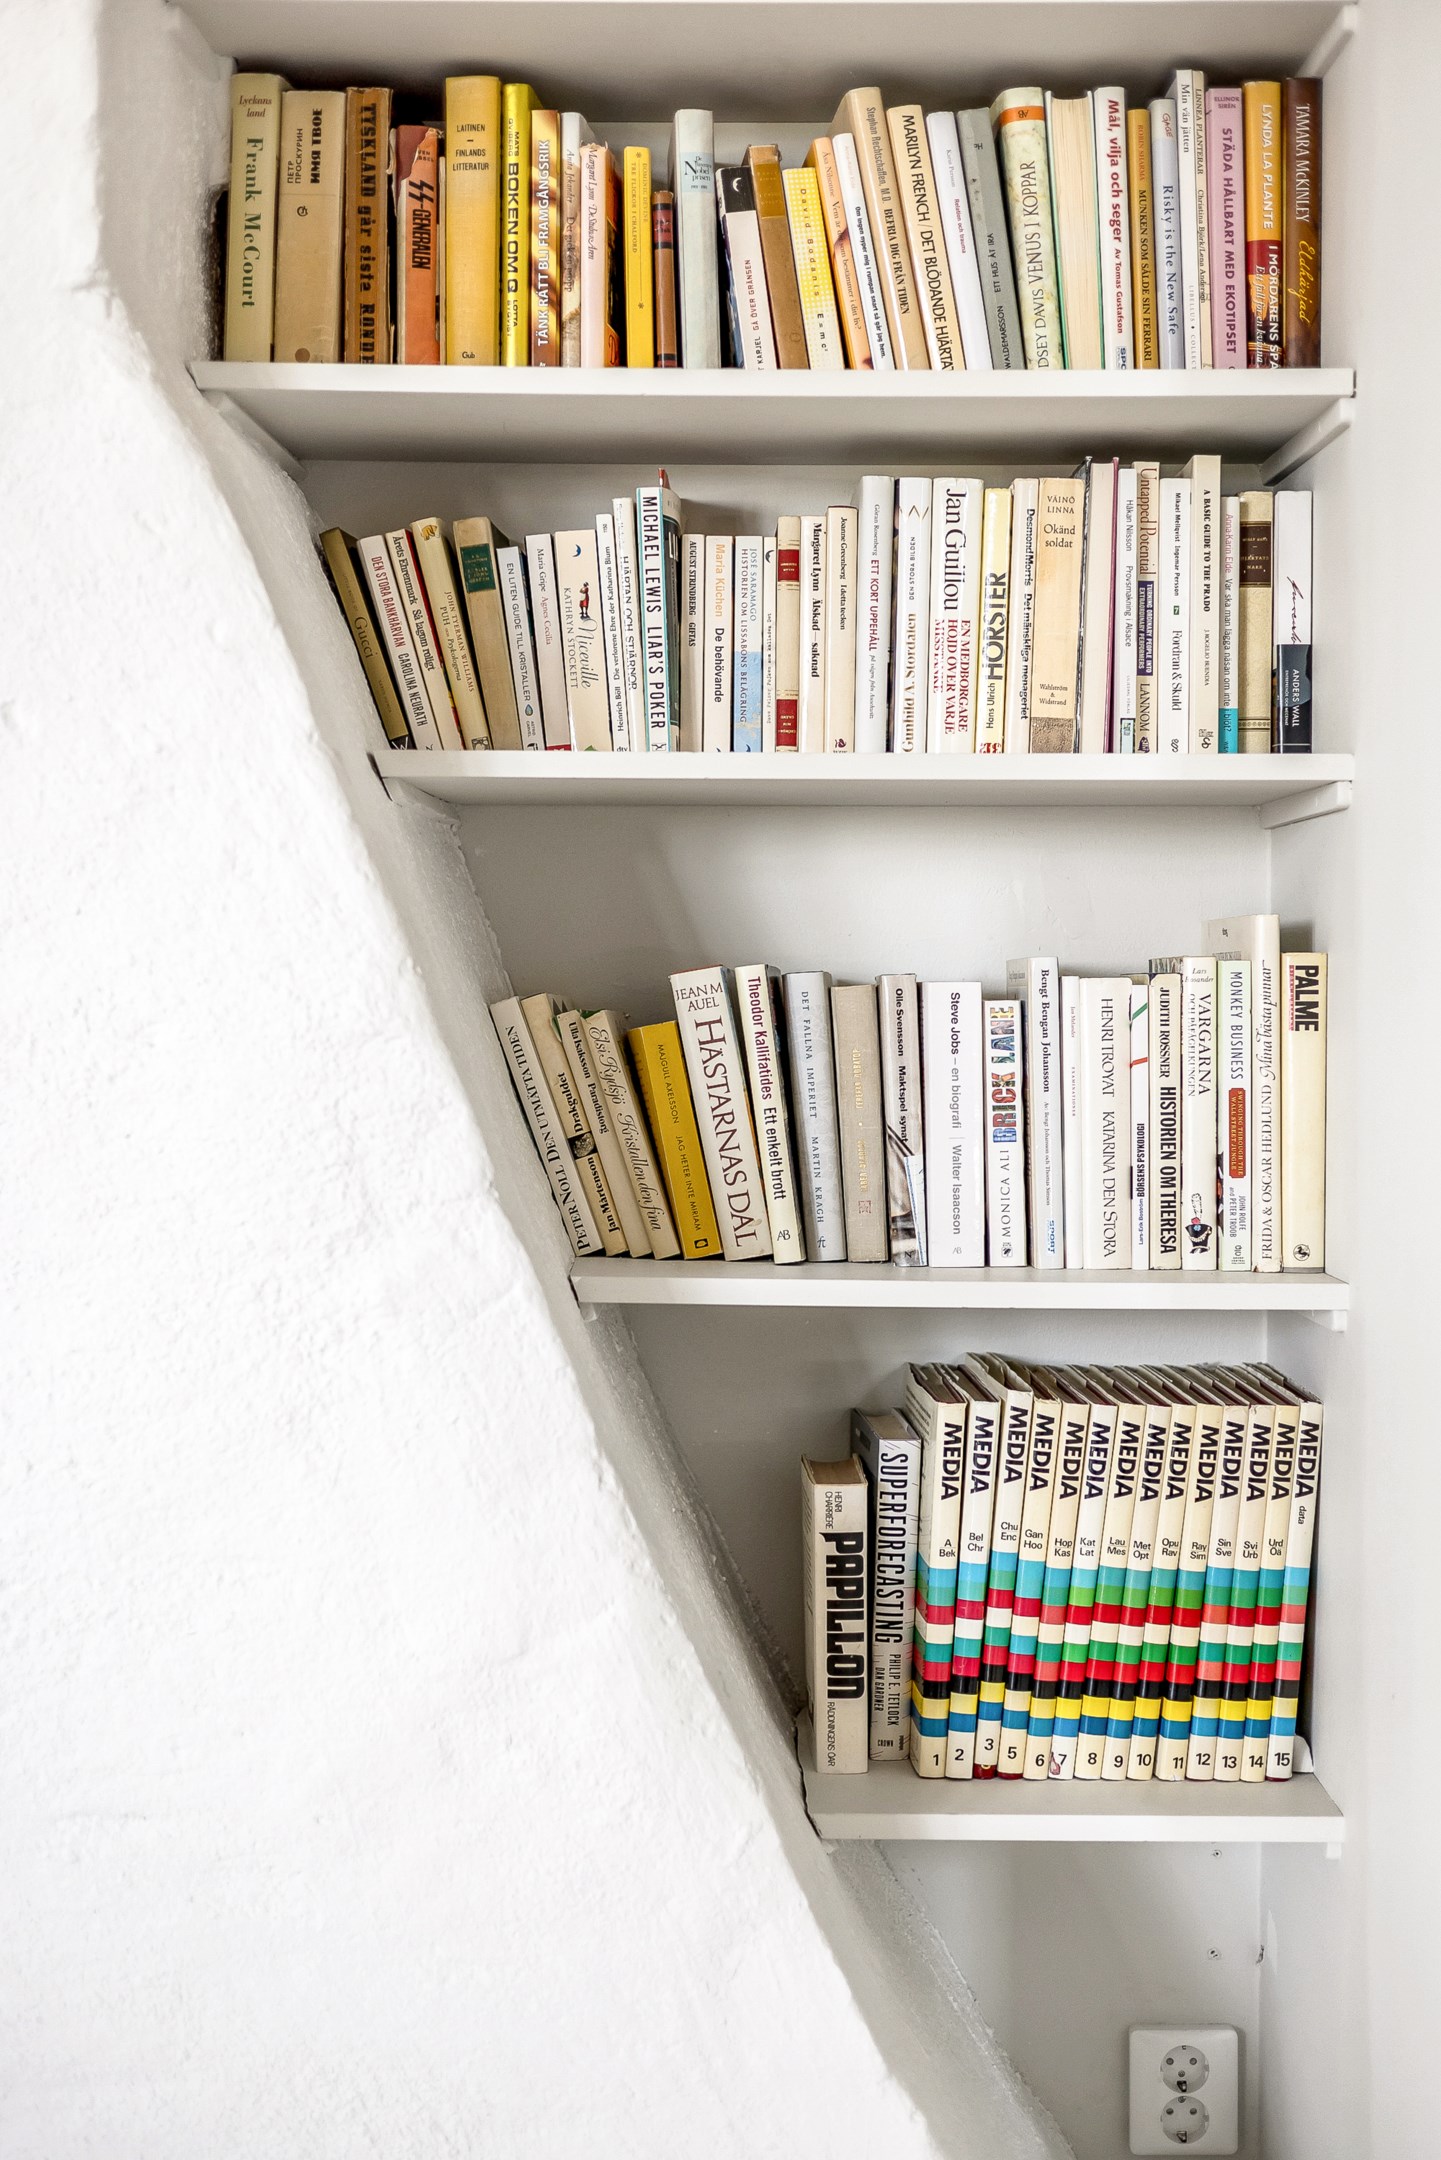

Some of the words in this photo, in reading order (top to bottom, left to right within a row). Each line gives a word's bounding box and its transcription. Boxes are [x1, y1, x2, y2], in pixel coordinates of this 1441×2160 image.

[239, 96, 272, 106] Lyckans
[247, 108, 265, 117] land
[1107, 99, 1123, 131] Mål,
[310, 108, 322, 147] ТВОЕ
[457, 124, 485, 133] LAITINEN
[901, 115, 922, 169] MARILYN
[1262, 104, 1273, 147] LYNDA
[1295, 103, 1311, 157] TAMARA
[295, 128, 303, 184] ПРОСКУРИН
[310, 151, 320, 184] ИМЯ
[360, 103, 376, 197] TYSKLAND
[453, 162, 489, 172] LITTERATUR
[456, 149, 486, 157] FINLANDS
[1106, 138, 1122, 167] vilja
[1222, 128, 1235, 172] STÄDA
[1263, 152, 1273, 169] LA
[245, 138, 263, 202] Frank
[1111, 172, 1123, 198] och
[507, 163, 518, 235] BOKEN
[536, 140, 551, 247] FRAMGÅNGSRIK
[911, 173, 930, 221] FRENCH
[1161, 185, 1175, 223] Risky
[1263, 174, 1273, 229] PLANTE
[1295, 160, 1311, 222] McKINLEY
[357, 206, 376, 236] går
[1109, 203, 1123, 243] seger
[1223, 178, 1237, 245] HÅLLBART
[919, 230, 935, 253] DET
[1165, 229, 1175, 240] is
[242, 213, 262, 308] McCourt
[360, 246, 375, 290] sista
[507, 240, 518, 273] OM
[538, 250, 550, 270] BLI
[1166, 245, 1176, 266] the
[1226, 251, 1235, 279] MED
[507, 278, 518, 294] Q
[537, 273, 550, 306] RÄTT
[924, 257, 946, 323] BLÖDANDE
[1167, 272, 1177, 301] New
[1288, 240, 1315, 322] Eldhärjad
[537, 310, 549, 346] TÄNK
[1168, 307, 1178, 335] Safe
[1226, 284, 1237, 354] EKOTIPSET
[945, 489, 967, 523] Jan
[1047, 495, 1075, 503] VÄINÖ
[1047, 506, 1075, 514] LINNA
[1136, 468, 1157, 523] Untapped
[1203, 498, 1211, 521] BASIC
[643, 496, 661, 561] MICHAEL
[1043, 524, 1076, 535] Okänd
[1045, 540, 1073, 548] soldat
[1203, 524, 1211, 548] GUIDE
[715, 544, 725, 573] Maria
[871, 559, 879, 574] ETT
[943, 529, 967, 611] Guillou
[1139, 527, 1156, 575] Potential
[1203, 551, 1211, 562] TO
[645, 568, 661, 613] LEWIS
[715, 578, 726, 617] Küchen
[870, 578, 879, 602] KORT
[1203, 583, 1211, 612] PRADO
[563, 588, 574, 634] KATHRYN
[869, 606, 880, 651] UPPEHÅLL
[354, 617, 378, 659] Gucci
[575, 619, 599, 689] Niceville
[647, 627, 663, 674] LIAR'S
[714, 628, 725, 642] De
[567, 638, 578, 689] STOCKETT
[714, 646, 725, 703] behövande
[1291, 669, 1300, 702] ANDERS
[650, 682, 666, 729] POKER
[1139, 683, 1150, 731] LANNOM
[1291, 705, 1300, 727] WALL
[748, 976, 761, 1027] Theodor
[951, 992, 960, 1024] Steve
[1159, 987, 1170, 1027] JUDITH
[1229, 972, 1244, 1018] MONKEY
[1295, 965, 1319, 1031] PALME
[990, 1007, 1015, 1063] LANE
[1102, 998, 1114, 1041] HENRI
[951, 1027, 960, 1055] Jobs
[1159, 1030, 1170, 1078] ROSSNER
[1198, 993, 1211, 1095] VARGARNA
[1230, 1025, 1244, 1080] BUSINESS
[754, 1031, 773, 1100] Kallifatides
[952, 1068, 959, 1082] en
[1102, 1044, 1115, 1097] TROYAT
[764, 1107, 777, 1124] Ett
[950, 1085, 961, 1129] biografi
[991, 1072, 1017, 1143] BRICK
[1160, 1087, 1176, 1160] HISTORIEN
[694, 1016, 746, 1186] HÄSTARNAS
[727, 1190, 757, 1248] DAL
[766, 1128, 782, 1167] enkelt
[1103, 1111, 1116, 1173] KATARINA
[952, 1145, 962, 1182] Walter
[1000, 1150, 1009, 1171] ALI
[1160, 1166, 1176, 1189] OM
[772, 1170, 786, 1200] brott
[1103, 1178, 1116, 1207] DEN
[952, 1184, 962, 1235] Isaacson
[1000, 1177, 1011, 1237] MONICA
[1160, 1193, 1176, 1254] THERESA
[1103, 1210, 1118, 1257] STORA
[941, 1422, 963, 1500] MEDIA
[970, 1416, 994, 1494] MEDIA
[1004, 1406, 1028, 1484] MEDIA
[1029, 1413, 1054, 1491] MEDIA
[1059, 1421, 1085, 1499] MEDIA
[1085, 1422, 1110, 1499] MEDIA
[1114, 1421, 1141, 1499] MEDIA
[1140, 1423, 1166, 1501] MEDIA
[1165, 1422, 1192, 1500] MEDIA
[1194, 1424, 1220, 1502] MEDIA
[1220, 1421, 1245, 1499] MEDIA
[1246, 1423, 1271, 1501] MEDIA
[1271, 1422, 1297, 1500] MEDIA
[1294, 1420, 1319, 1498] MEDIA
[825, 1491, 834, 1530] CHARRIÈRE
[1298, 1505, 1306, 1524] data
[875, 1453, 908, 1643] SUPERFORECASTING
[819, 1532, 865, 1699] PAPILLON
[875, 1668, 885, 1680] DAN
[888, 1682, 900, 1690] E.
[889, 1654, 901, 1681] PHILIP
[874, 1682, 884, 1711] GARDNER
[887, 1693, 899, 1726] TETLOCK
[827, 1702, 836, 1750] RÄDDNINGENS
[984, 1739, 993, 1751] 3
[827, 1752, 836, 1766] ÖAR
[933, 1754, 938, 1766] 1
[955, 1749, 964, 1761] 2
[1008, 1747, 1017, 1759] 5
[1035, 1754, 1044, 1766] 6
[1058, 1754, 1066, 1766] 7
[1088, 1753, 1097, 1765] 8
[1114, 1755, 1122, 1768] 9
[1137, 1754, 1151, 1766] 10
[1173, 1757, 1183, 1768] 11
[1196, 1753, 1211, 1765] 12
[1222, 1756, 1237, 1768] 13
[1249, 1755, 1263, 1767] 14
[1275, 1753, 1290, 1766] 15
